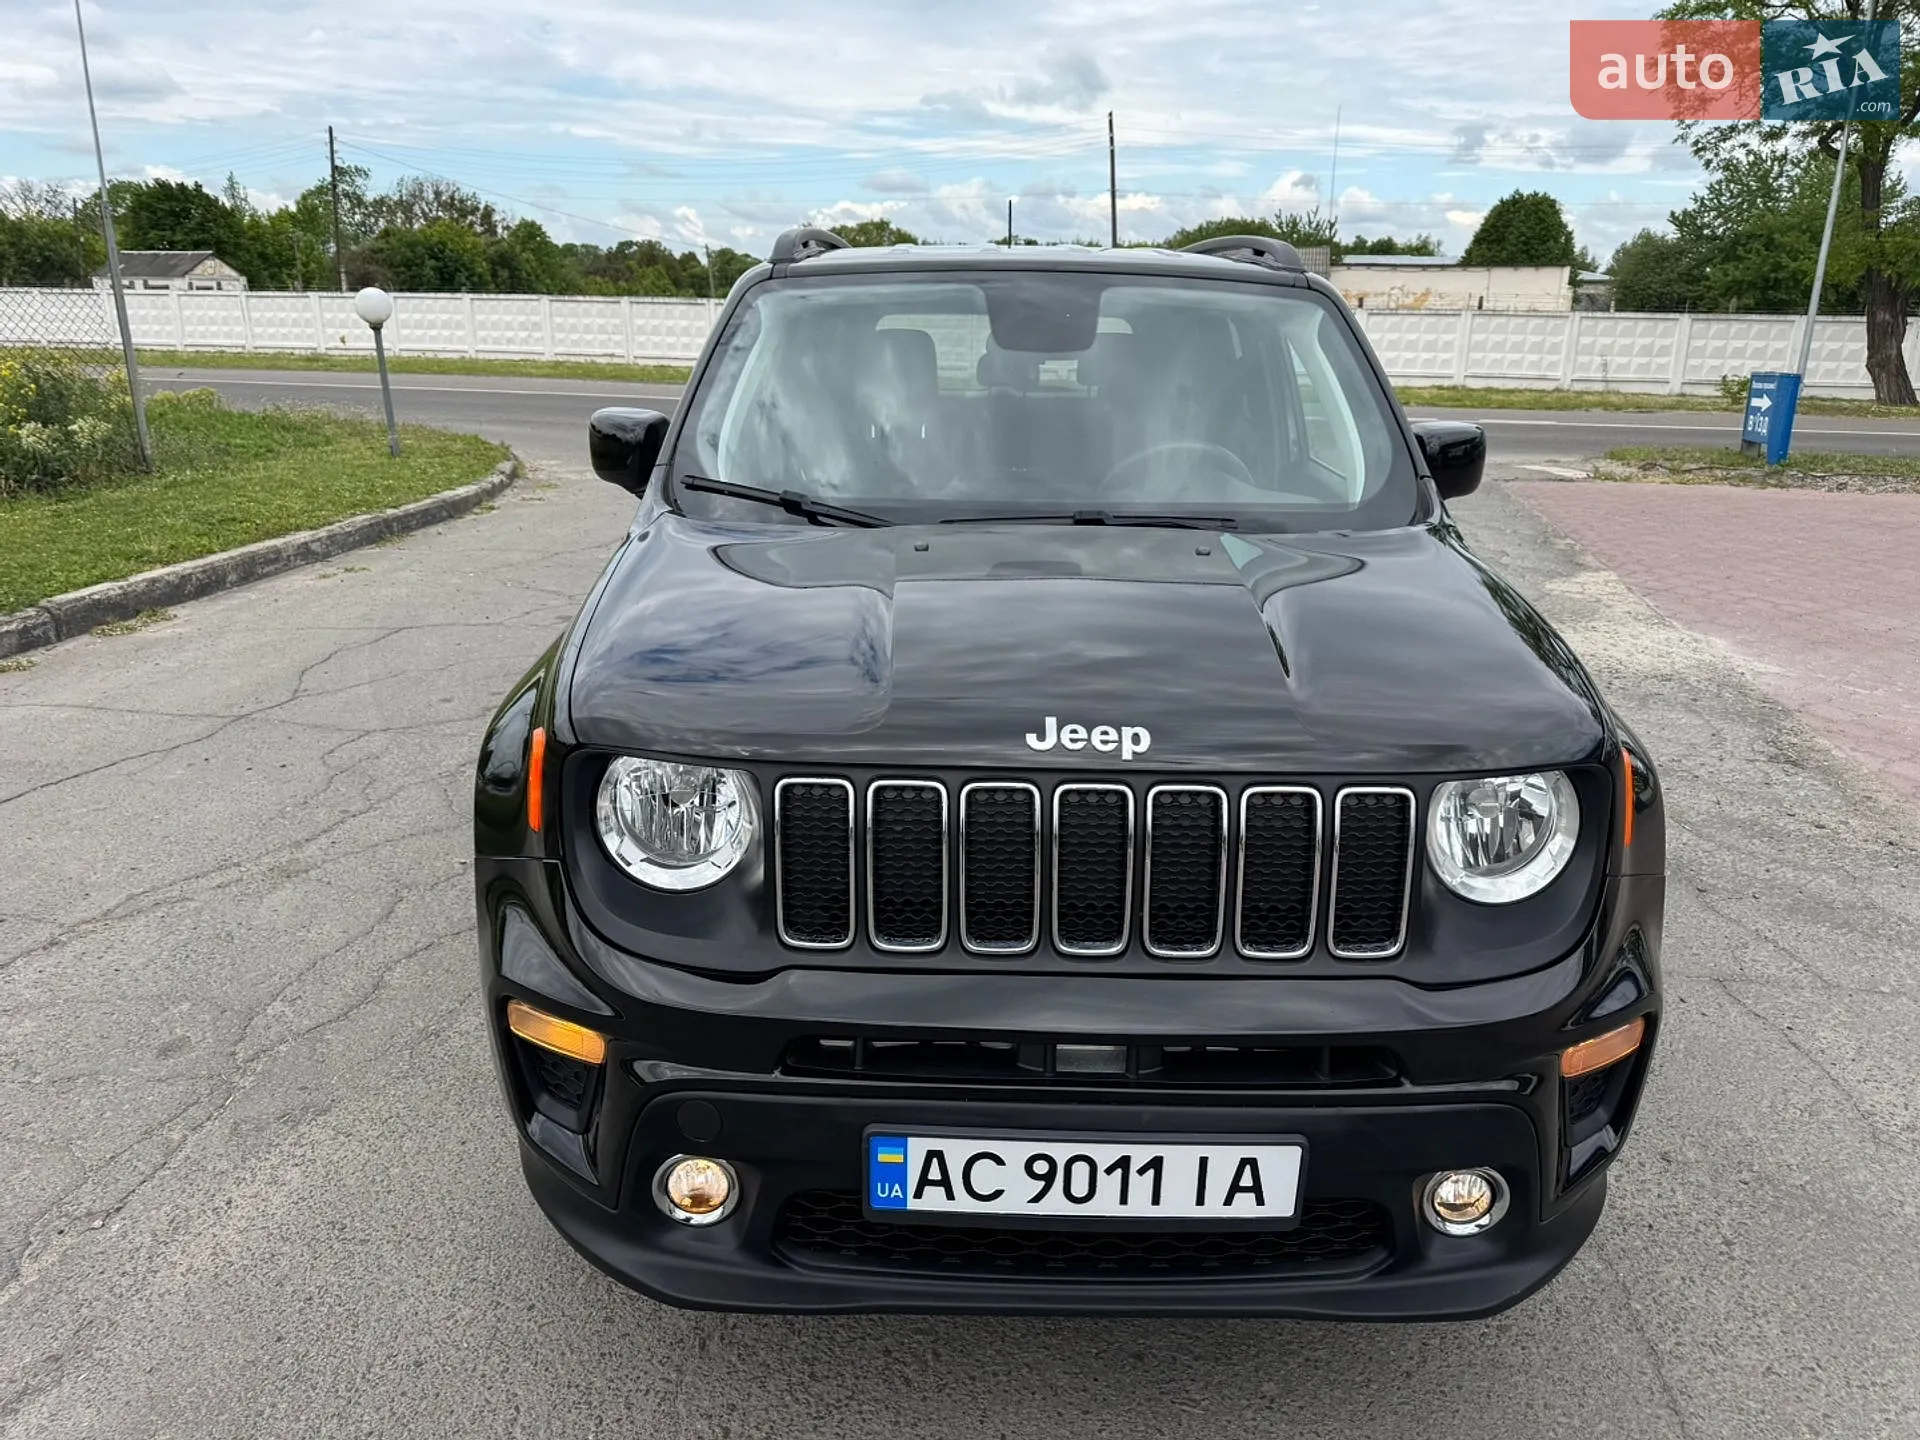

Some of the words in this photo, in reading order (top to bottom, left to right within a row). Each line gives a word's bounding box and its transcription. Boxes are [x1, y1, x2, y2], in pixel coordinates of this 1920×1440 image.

[1025, 716, 1151, 761] Jeep
[877, 1182, 904, 1199] UA
[912, 1149, 1007, 1202] AC
[1024, 1153, 1164, 1206] 9011
[1194, 1156, 1266, 1207] IA
